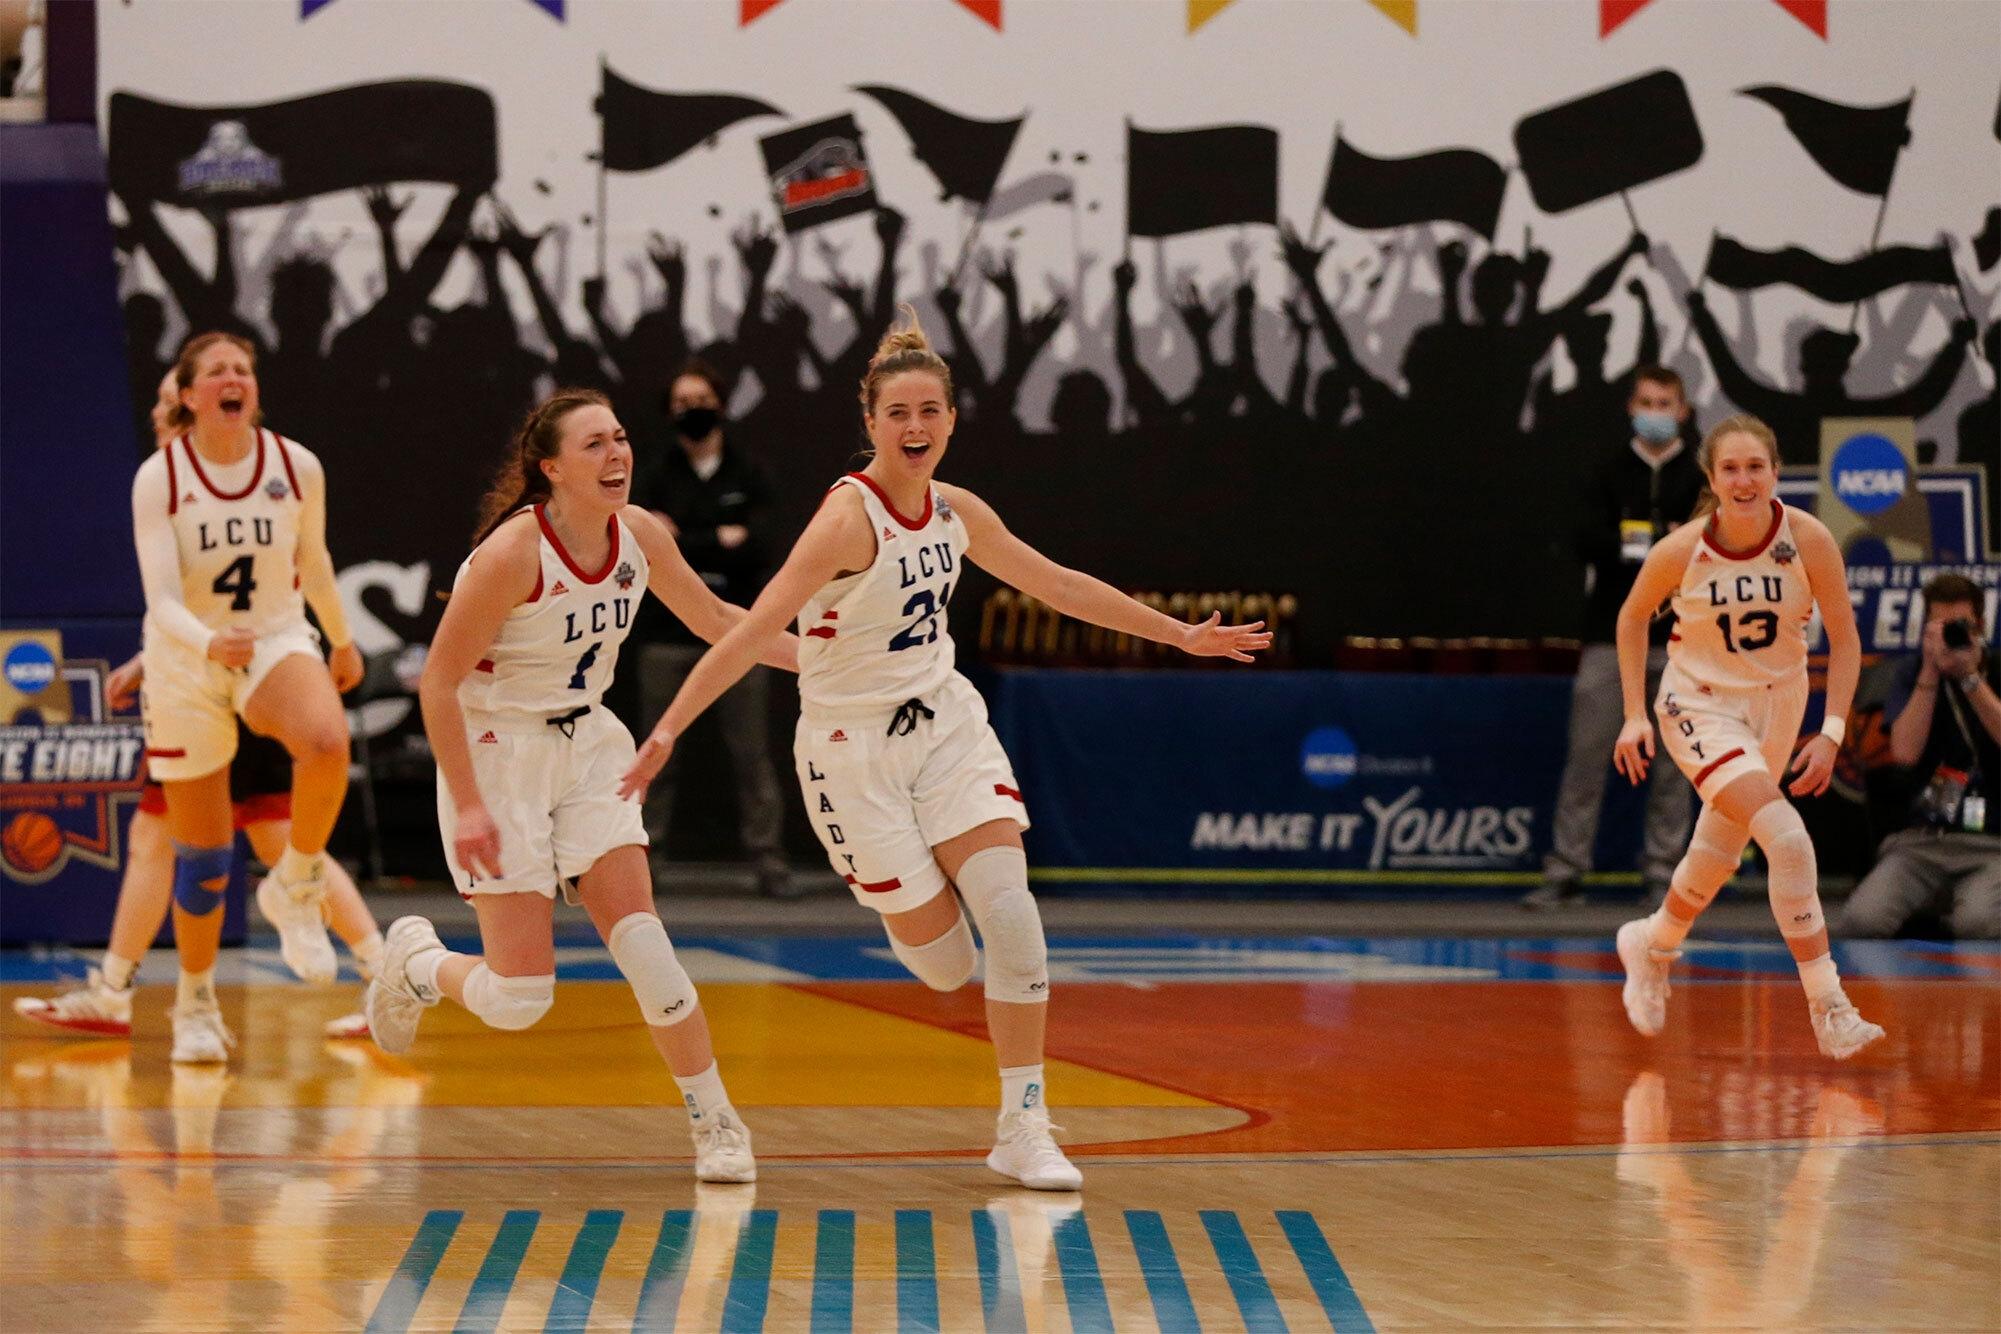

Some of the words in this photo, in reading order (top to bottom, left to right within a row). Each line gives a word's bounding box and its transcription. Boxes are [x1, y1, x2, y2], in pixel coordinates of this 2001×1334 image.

[1838, 470, 1906, 496] NCAA
[199, 517, 271, 551] LCU
[213, 554, 256, 611] 4
[898, 543, 953, 589] LCU
[1709, 576, 1782, 606] LCU
[564, 599, 629, 643] LCU
[887, 582, 950, 651] 21
[1716, 609, 1779, 653] 13
[31, 739, 140, 781] EIGHT
[808, 760, 857, 873] LADY
[1191, 812, 1314, 850] MAKE
[1320, 813, 1364, 850] IT
[1363, 785, 1534, 871] YOURS
